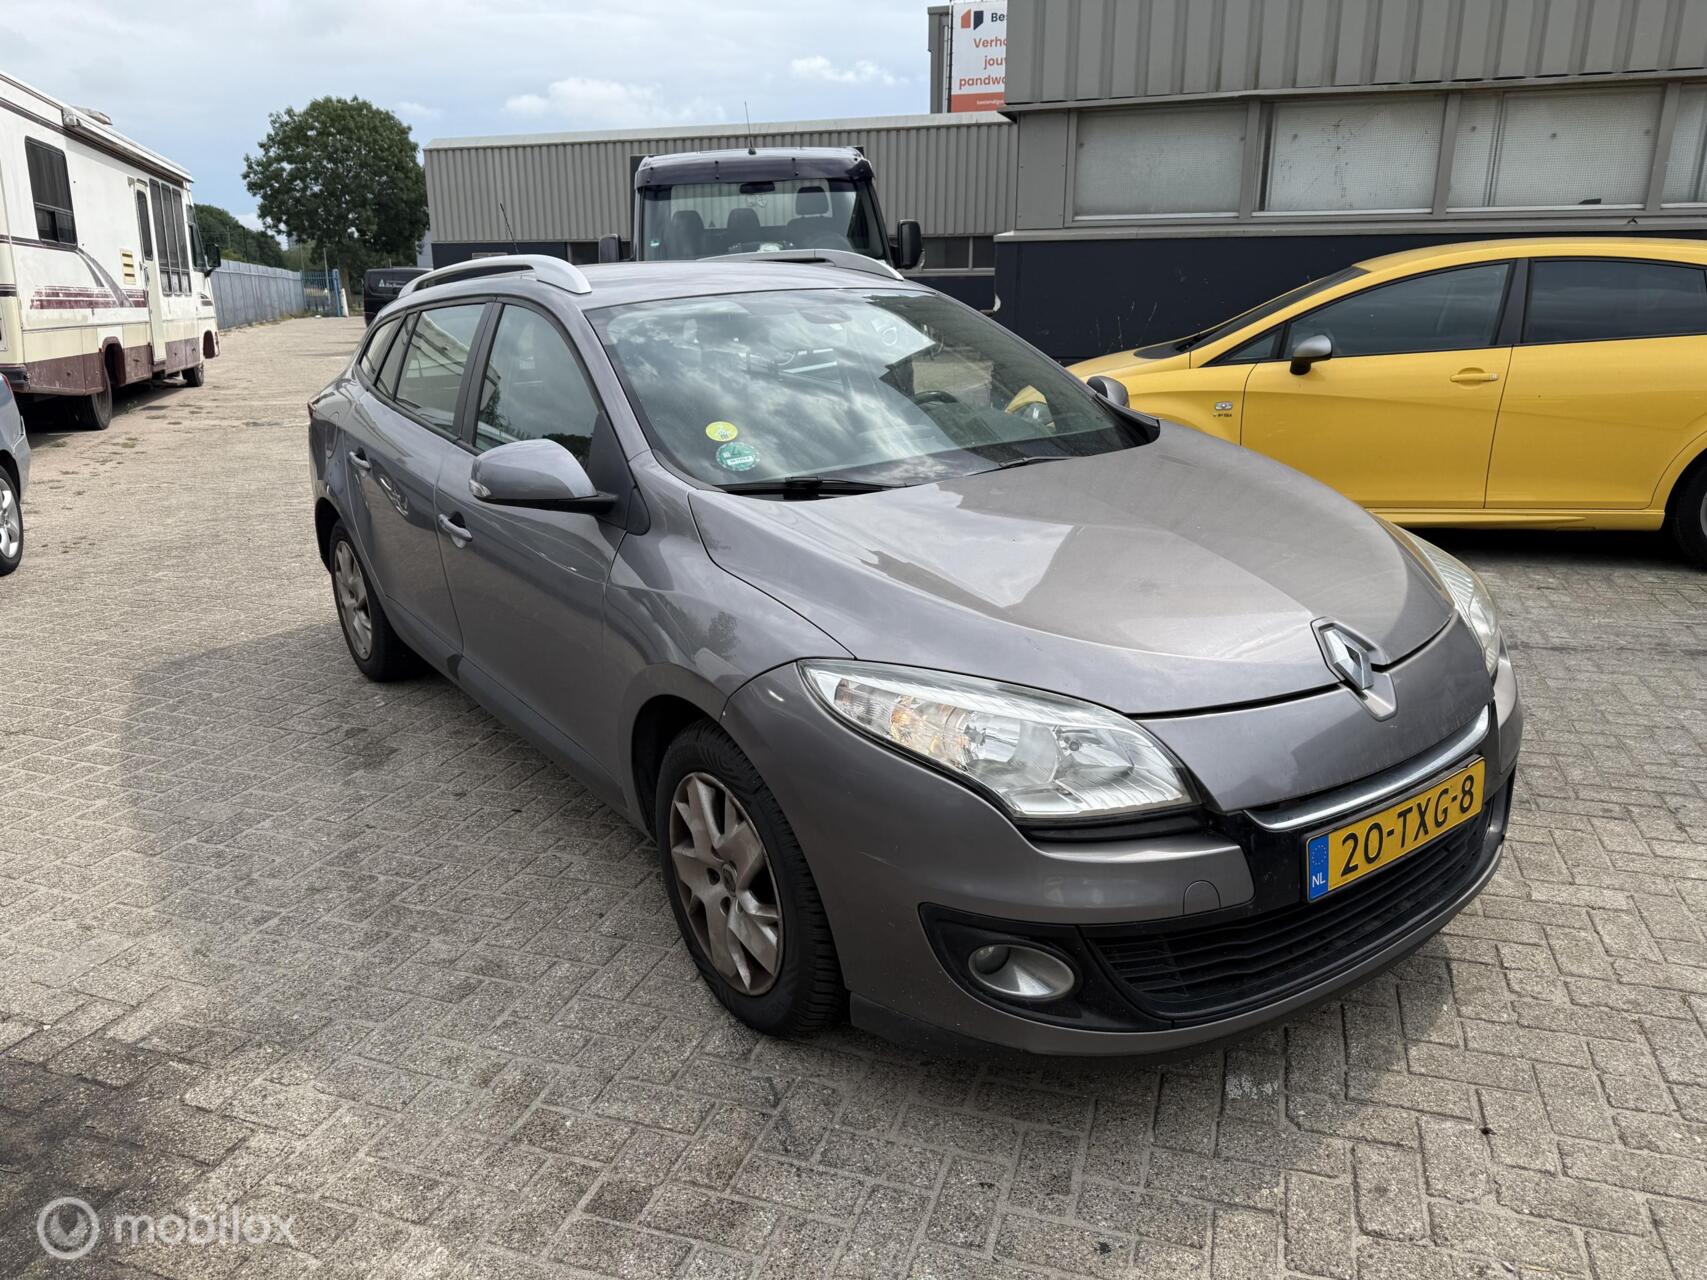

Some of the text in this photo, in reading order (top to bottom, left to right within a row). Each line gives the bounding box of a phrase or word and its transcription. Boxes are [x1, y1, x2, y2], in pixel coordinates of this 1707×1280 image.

[991, 12, 1007, 22] Be
[1340, 774, 1475, 877] 20-TXG-8
[1312, 871, 1326, 888] NL
